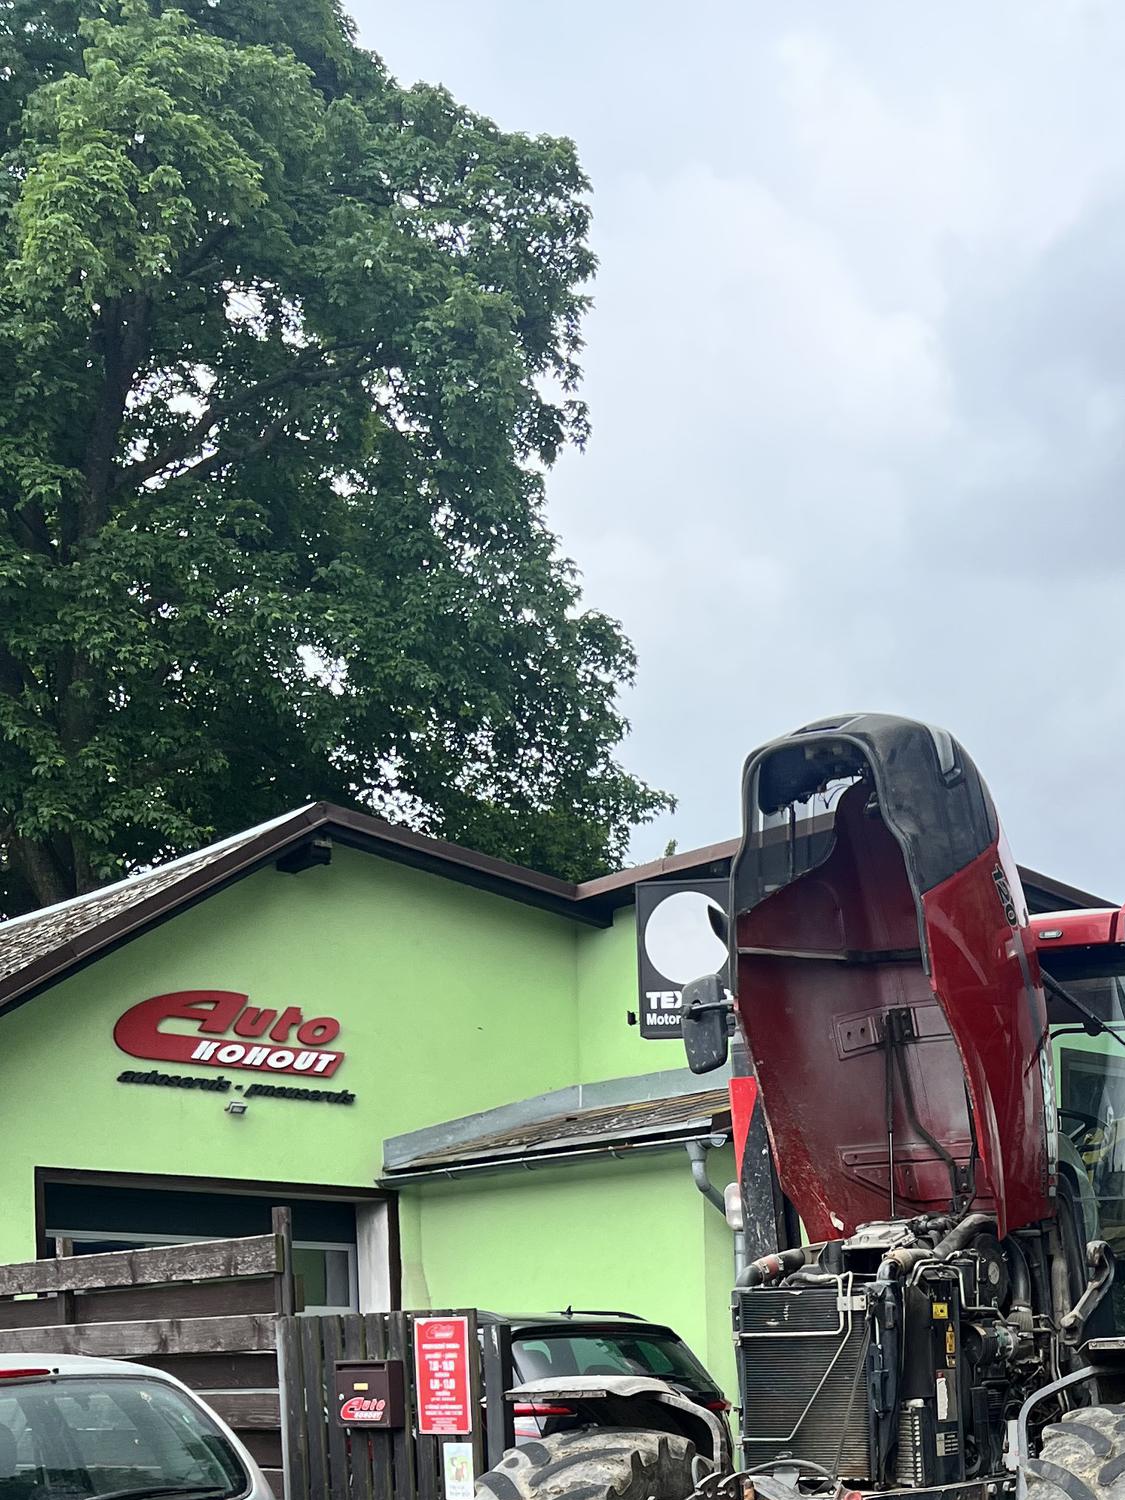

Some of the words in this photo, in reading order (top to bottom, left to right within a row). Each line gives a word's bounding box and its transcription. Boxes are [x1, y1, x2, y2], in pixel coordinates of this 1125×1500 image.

[113, 989, 340, 1046] Auto
[646, 1012, 681, 1026] Motor
[190, 1040, 337, 1074] KOHOUT
[117, 1070, 232, 1092] autoservis
[243, 1083, 356, 1105] pneuservis
[340, 1396, 386, 1412] Auto
